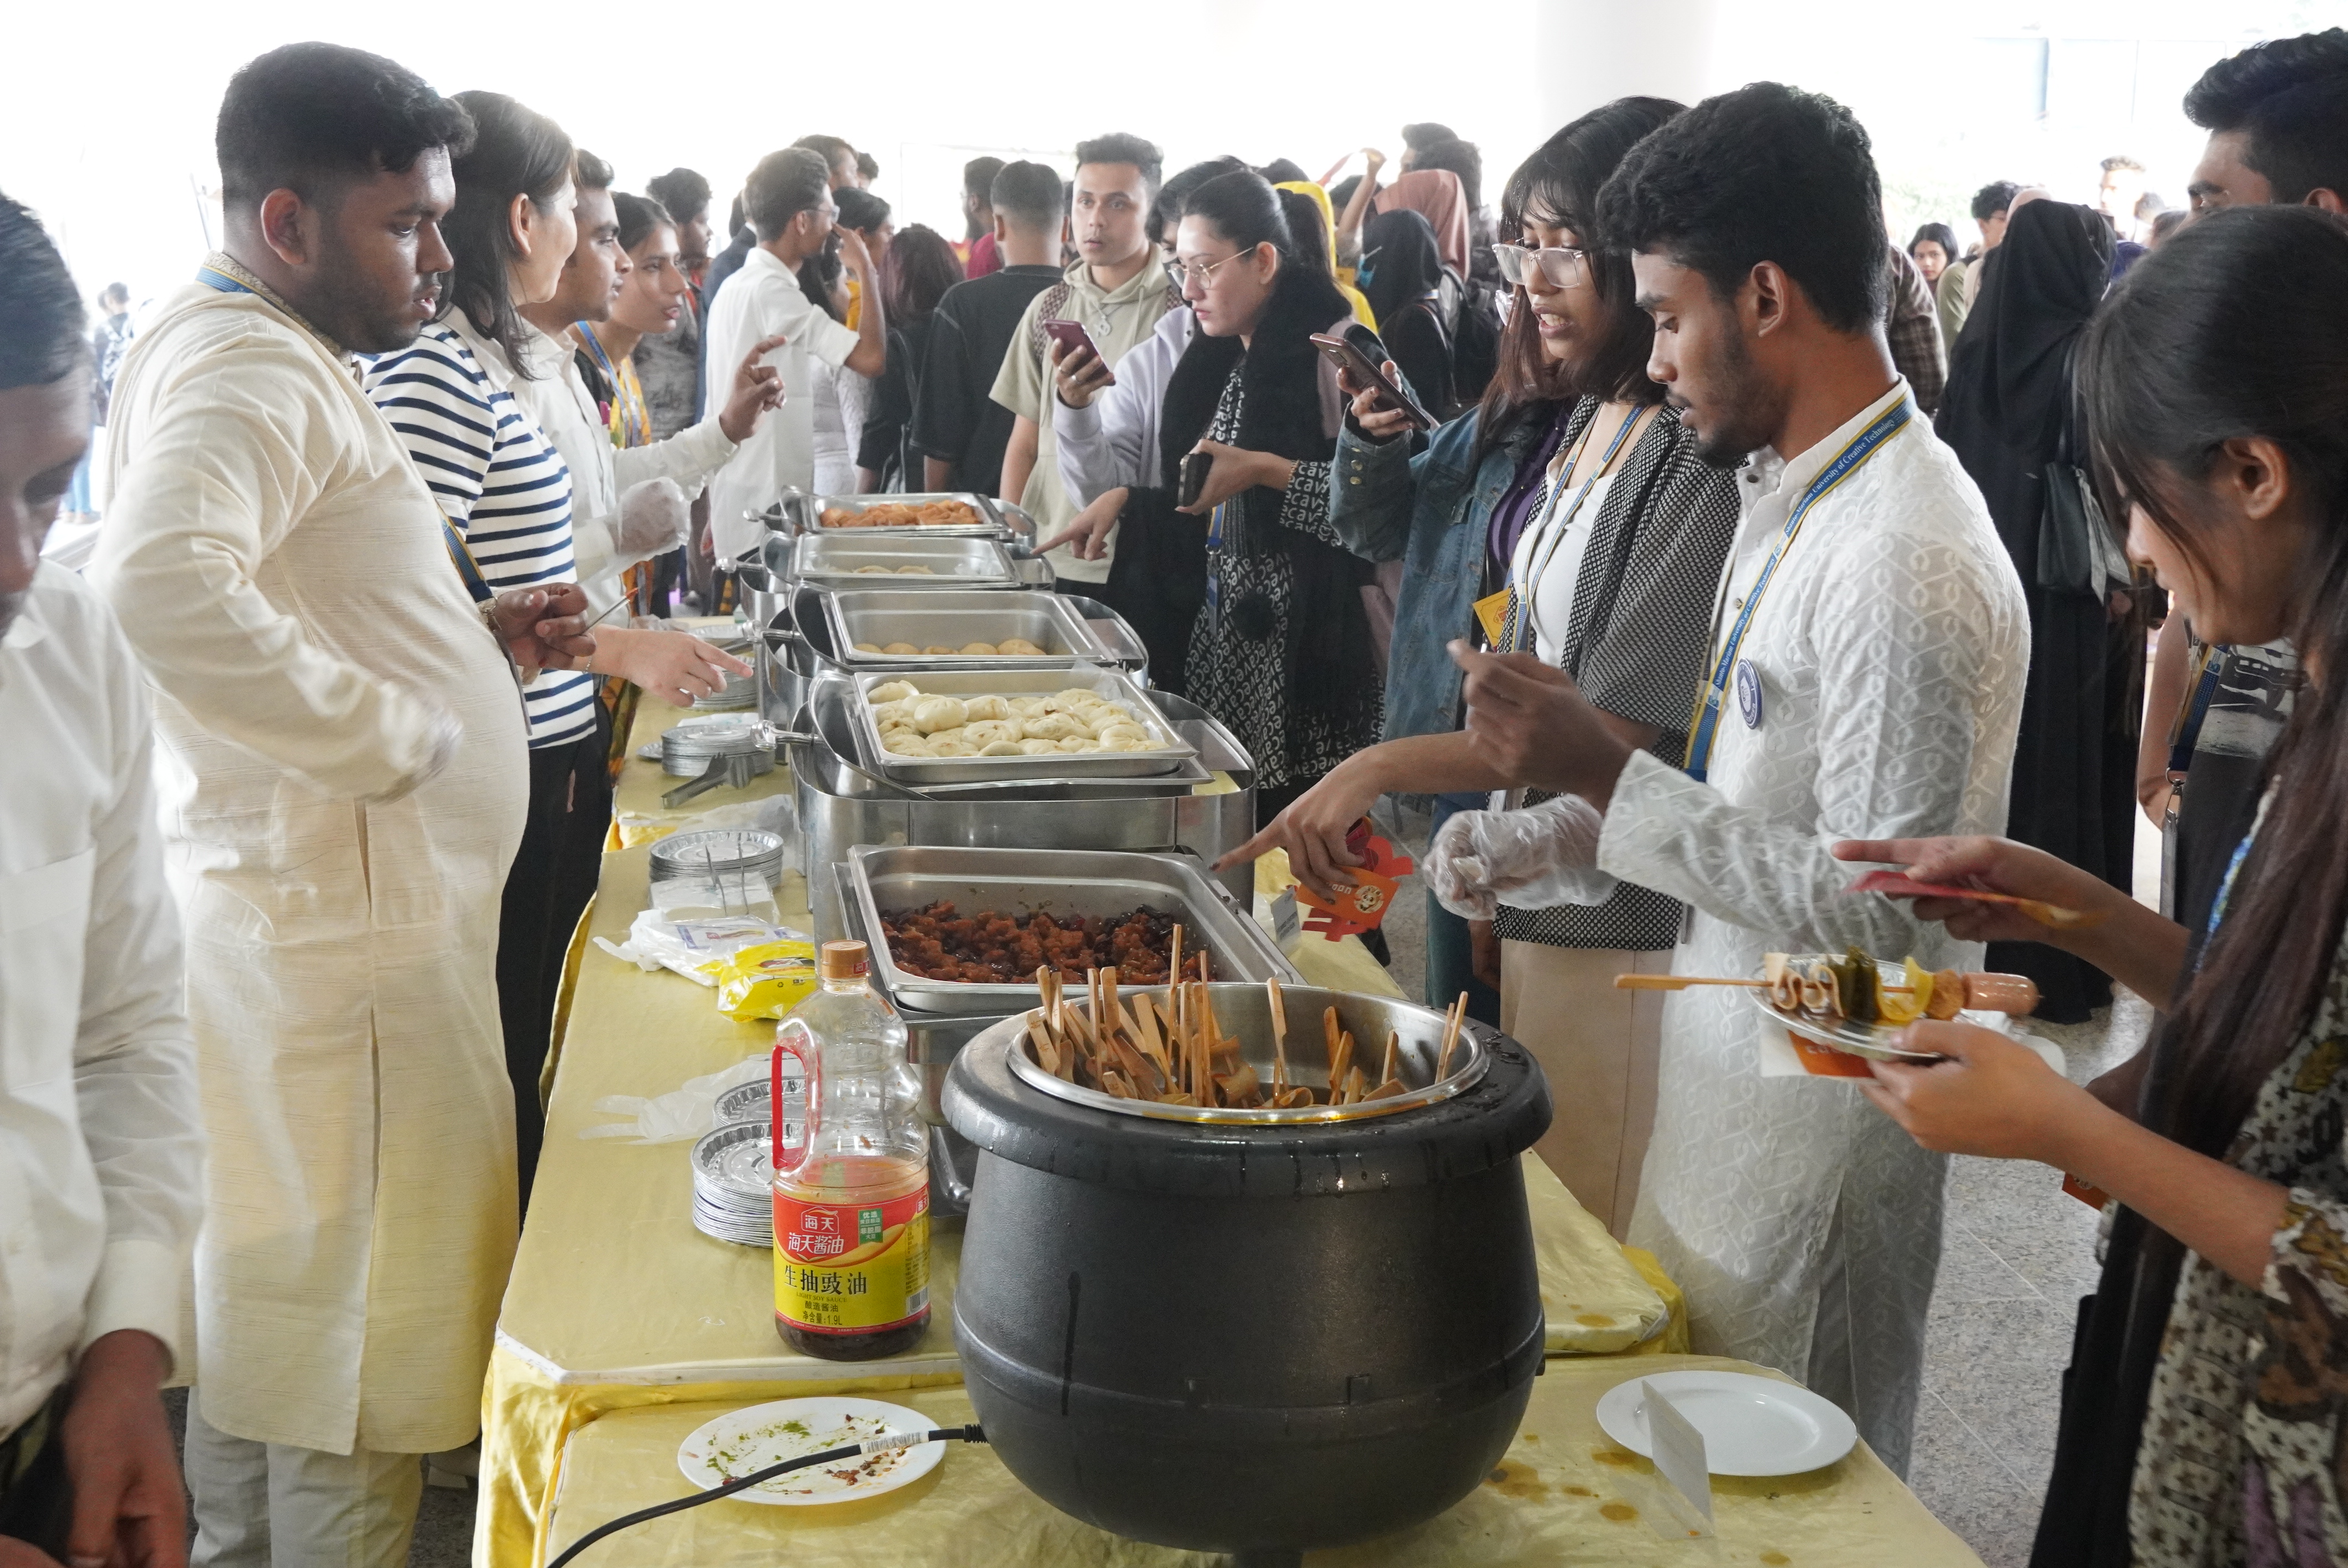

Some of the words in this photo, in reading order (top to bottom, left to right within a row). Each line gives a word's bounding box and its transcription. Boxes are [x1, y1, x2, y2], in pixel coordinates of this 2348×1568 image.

[1556, 464, 1572, 491] Technology
[1785, 493, 1814, 535] Shanto-Mariam
[1812, 467, 1840, 493] University
[1837, 460, 1845, 470] of
[1842, 441, 1867, 464] Creative
[1863, 419, 1896, 443] Technology
[1716, 647, 1733, 688] Shanto-Mariam
[1730, 620, 1745, 645] University
[1744, 610, 1749, 619] of
[1747, 587, 1760, 613] Creative
[1759, 558, 1775, 588] Technology
[805, 1214, 834, 1231] 海天
[863, 1210, 878, 1219] 优选
[788, 1232, 845, 1255] 海天酱油
[784, 1265, 867, 1295] 生抽豉油
[796, 1292, 812, 1300] LIGHT
[805, 1301, 839, 1313] 酿造酱油
